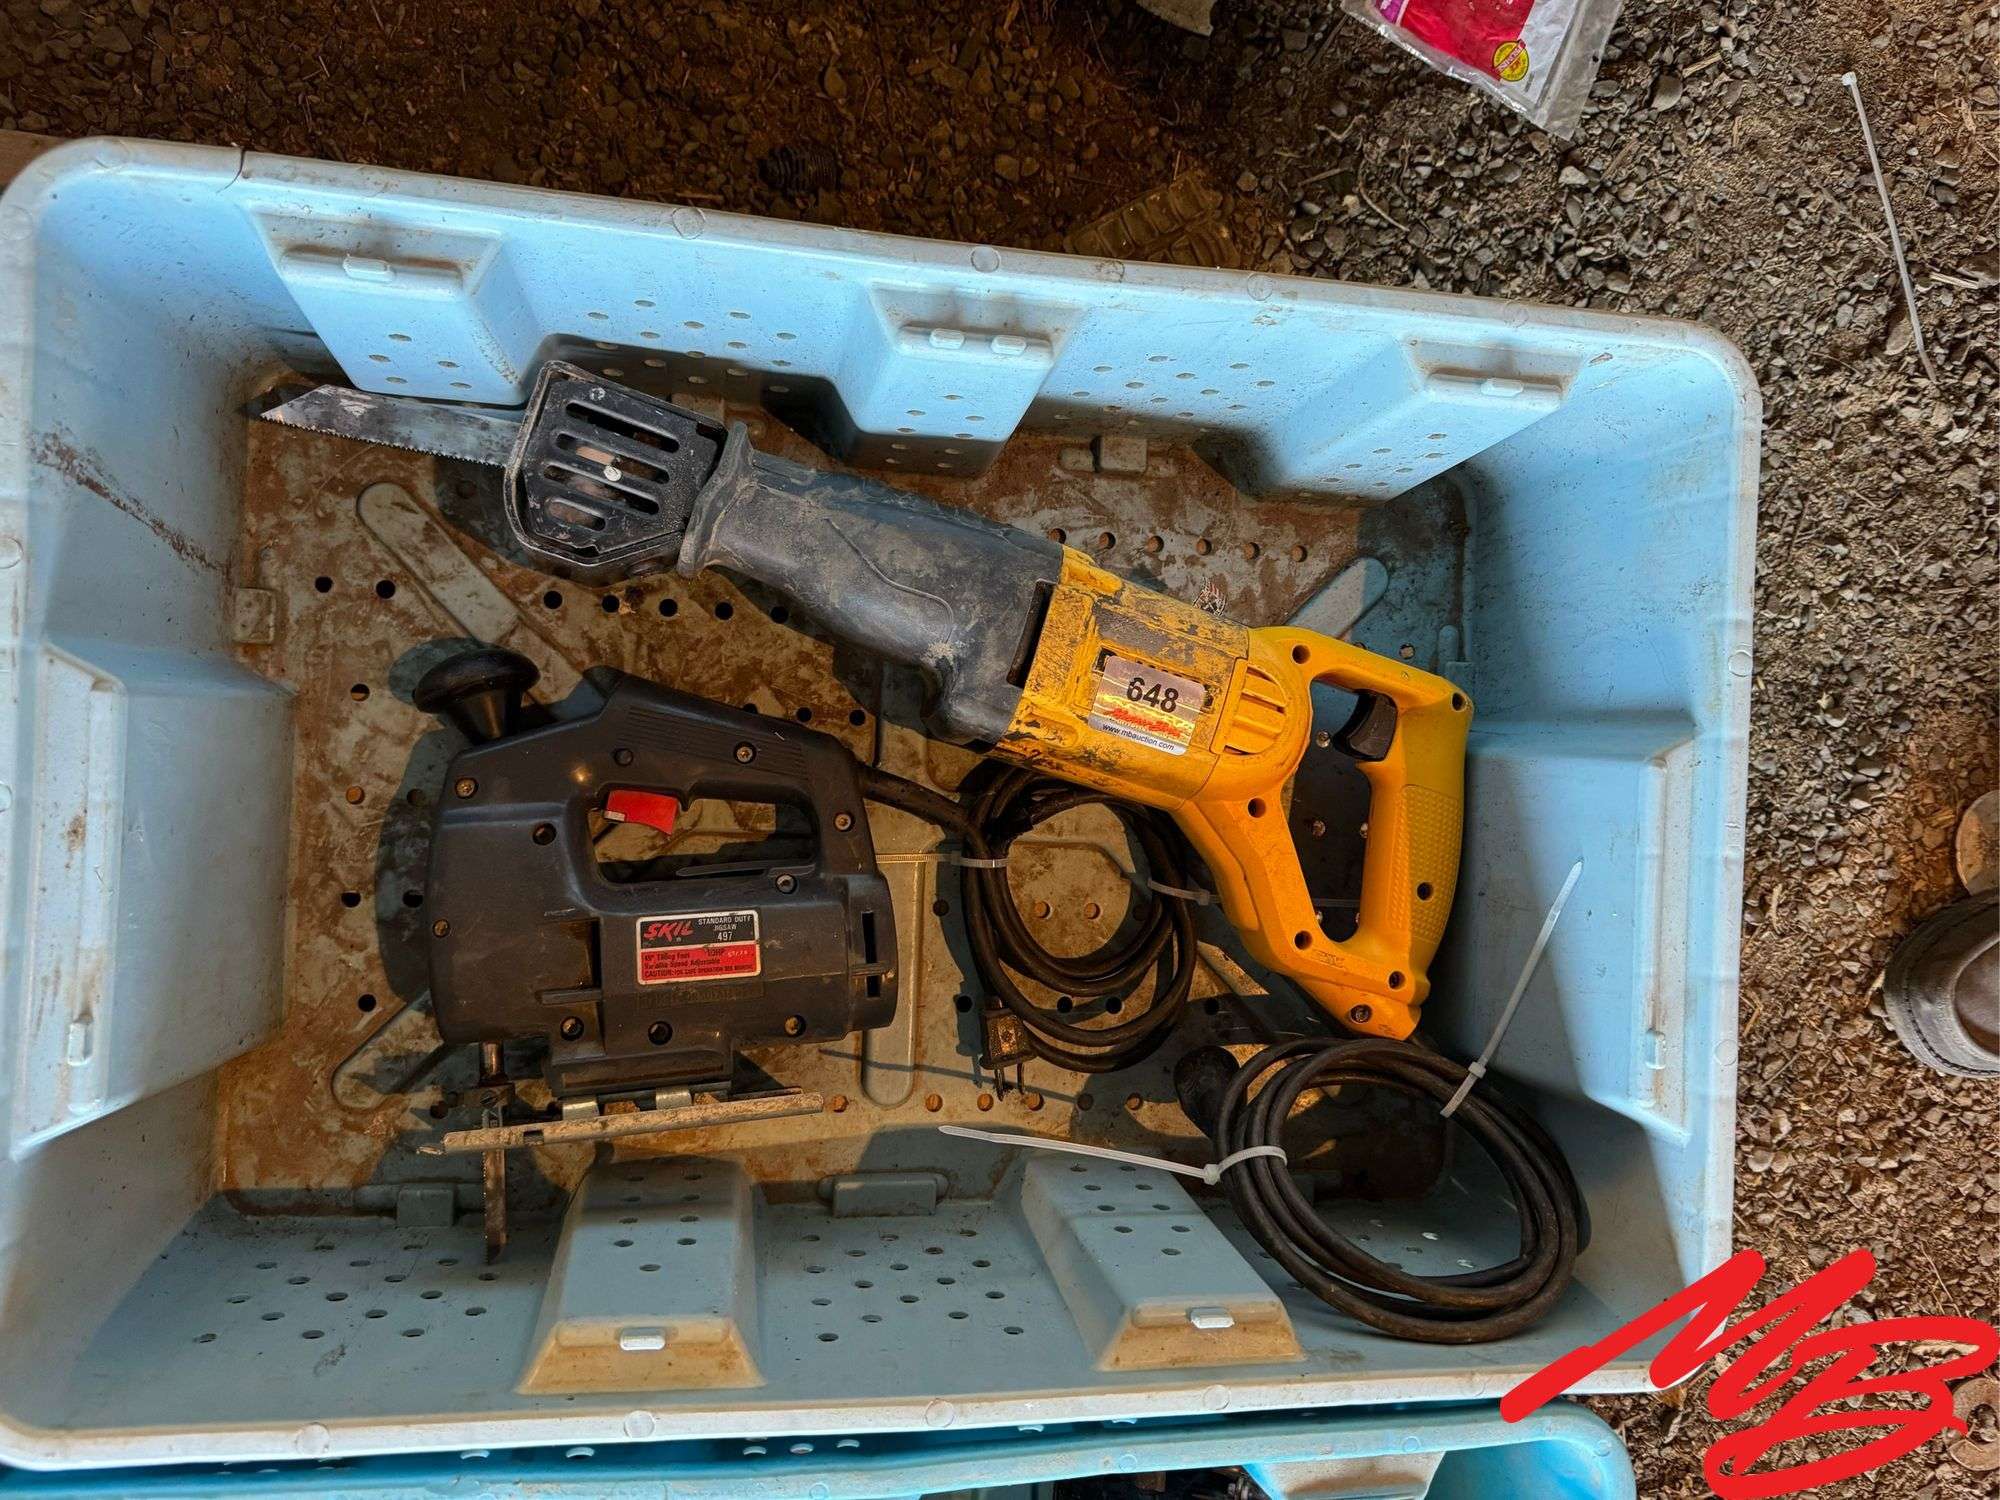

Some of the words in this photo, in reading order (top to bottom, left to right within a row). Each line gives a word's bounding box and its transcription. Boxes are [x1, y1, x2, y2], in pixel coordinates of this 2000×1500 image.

[1127, 677, 1179, 713] 648
[1102, 723, 1174, 750] www.mbauction.com
[698, 916, 732, 926] STANDARD
[734, 915, 752, 923] DUTY
[714, 924, 737, 932] JIGSAW
[643, 921, 694, 942] SKIL
[717, 931, 733, 941] 497
